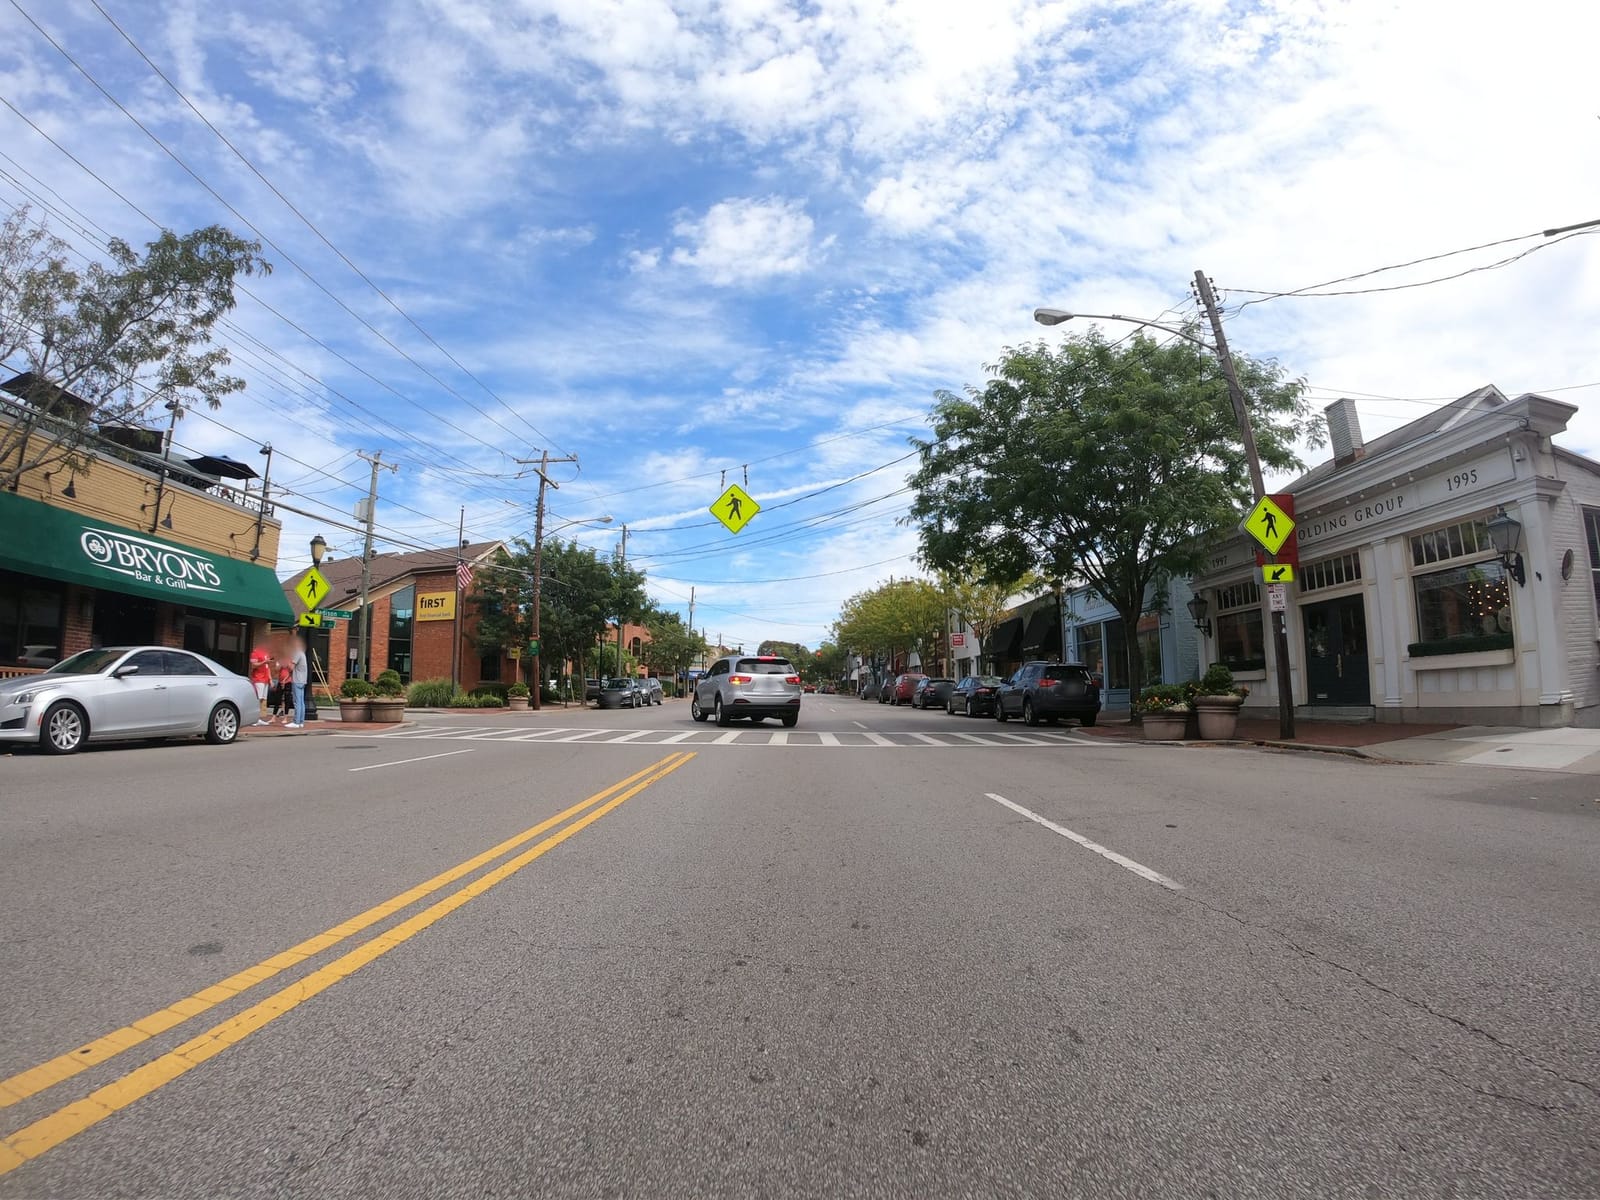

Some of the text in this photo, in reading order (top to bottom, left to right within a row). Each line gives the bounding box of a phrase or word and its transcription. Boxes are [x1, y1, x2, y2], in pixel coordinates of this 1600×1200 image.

[1446, 469, 1478, 491] 1995
[1298, 495, 1404, 541] OLDING GROUP
[81, 531, 221, 586] O'BRYON'S
[135, 570, 187, 590] Bar & Grill
